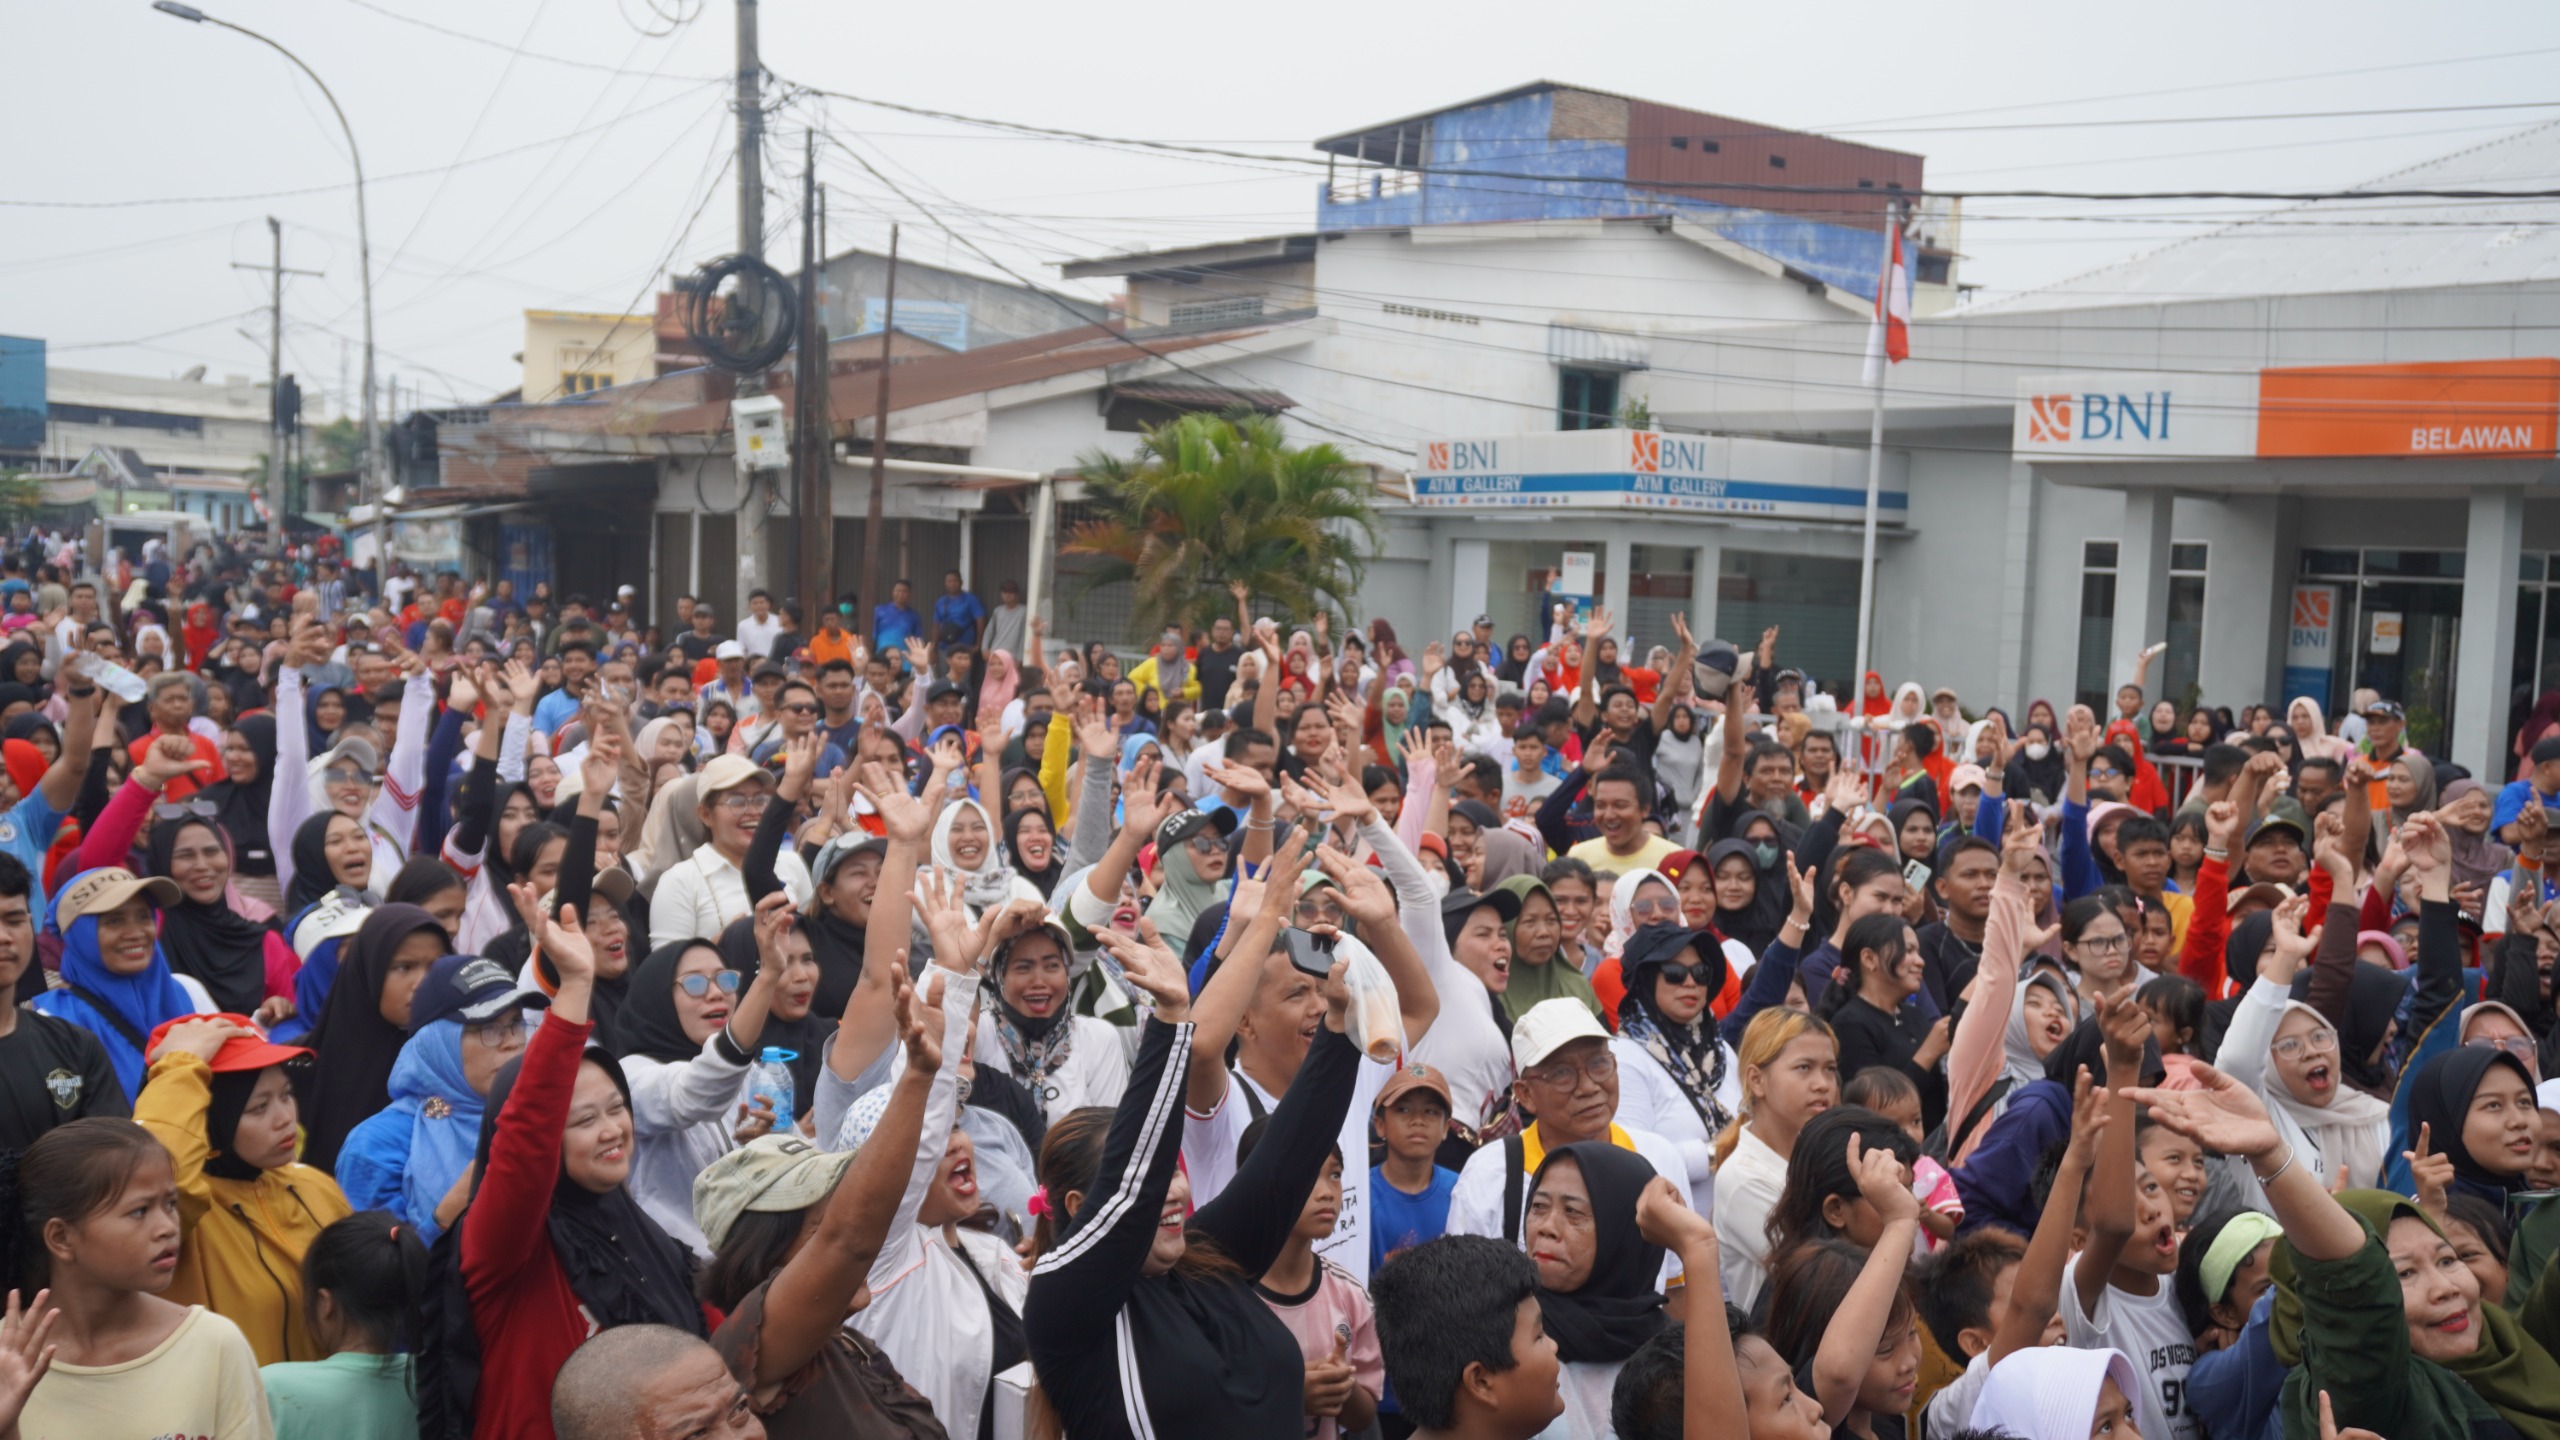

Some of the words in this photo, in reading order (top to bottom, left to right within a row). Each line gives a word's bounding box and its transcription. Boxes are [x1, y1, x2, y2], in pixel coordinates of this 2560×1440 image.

[2081, 391, 2171, 441] BNI
[2411, 425, 2532, 450] BELAWAN
[1453, 441, 1497, 470] BNI
[1661, 439, 1706, 471] BNI
[1428, 477, 1457, 493] ATM
[1462, 476, 1522, 491] GALLERY
[1633, 475, 1663, 492] ATM
[1669, 478, 1727, 497] GALLERY
[2292, 629, 2327, 648] BNI
